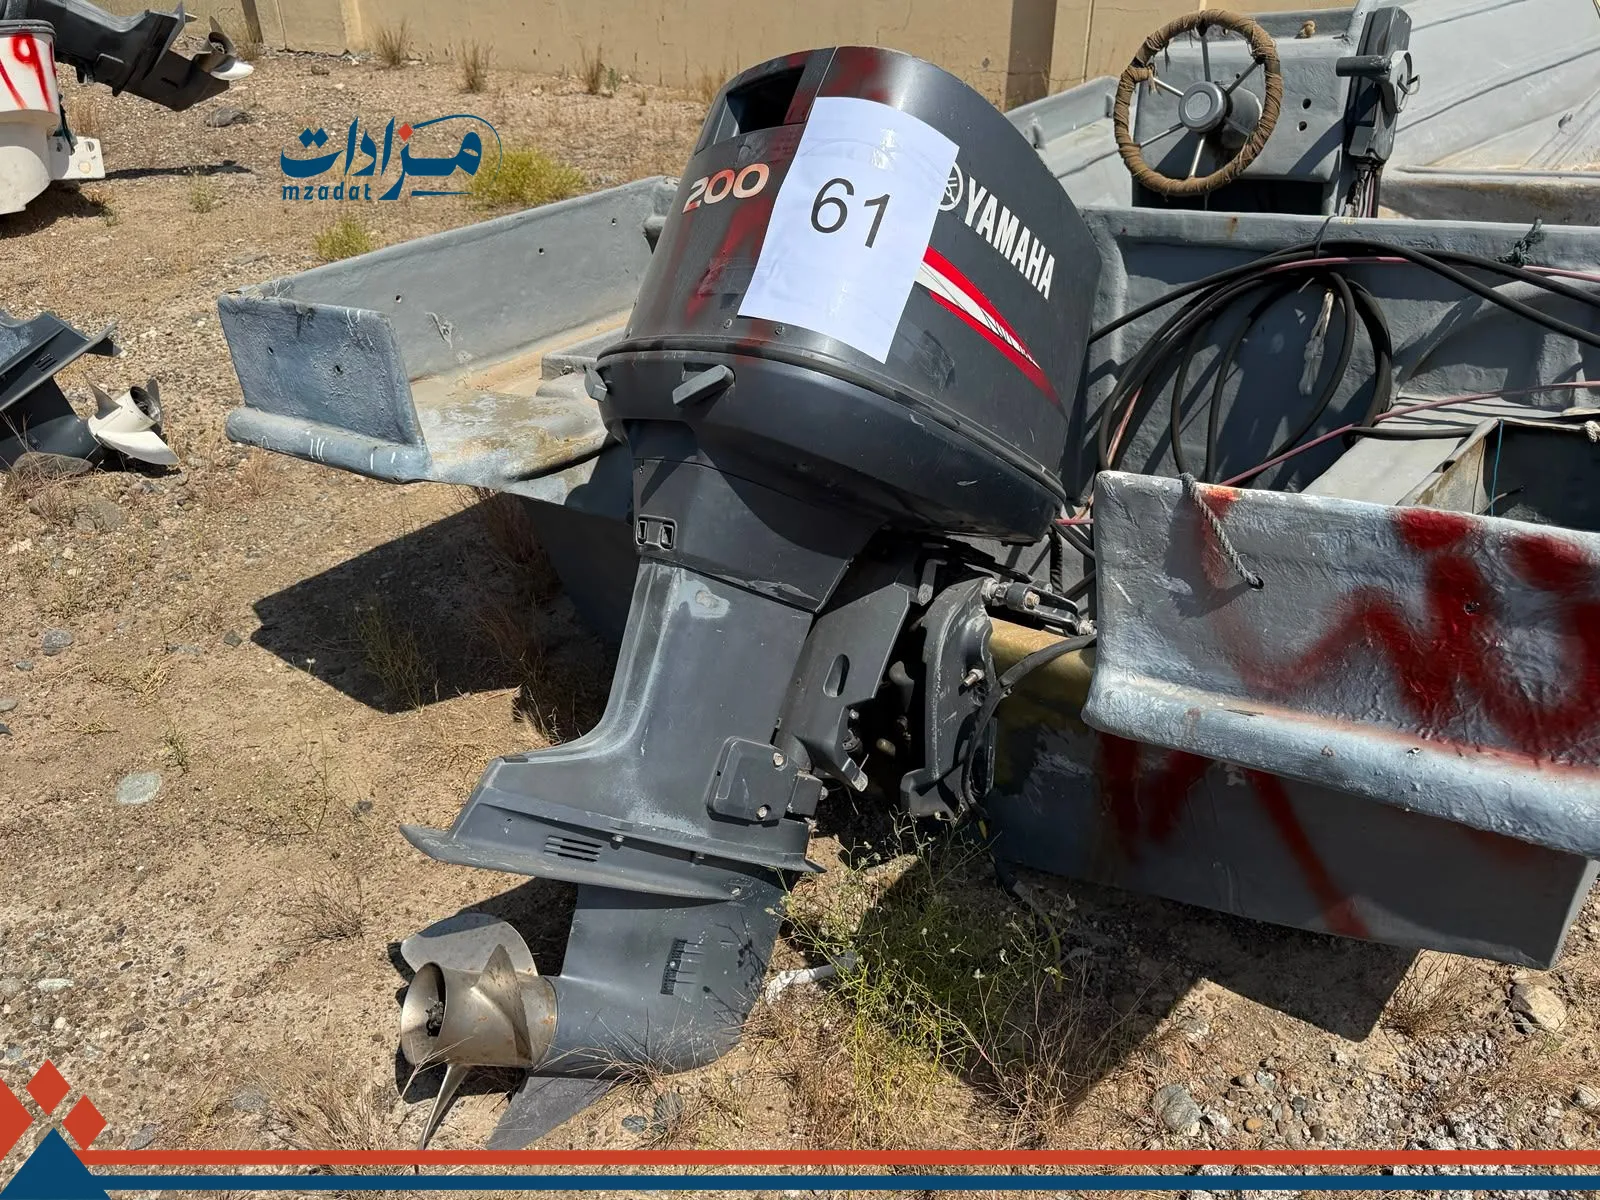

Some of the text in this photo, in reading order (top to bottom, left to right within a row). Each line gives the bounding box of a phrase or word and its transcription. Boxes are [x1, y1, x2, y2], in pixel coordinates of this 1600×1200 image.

[681, 163, 770, 214] 200
[811, 178, 891, 248] 61
[964, 176, 1056, 300] YAMAHA
